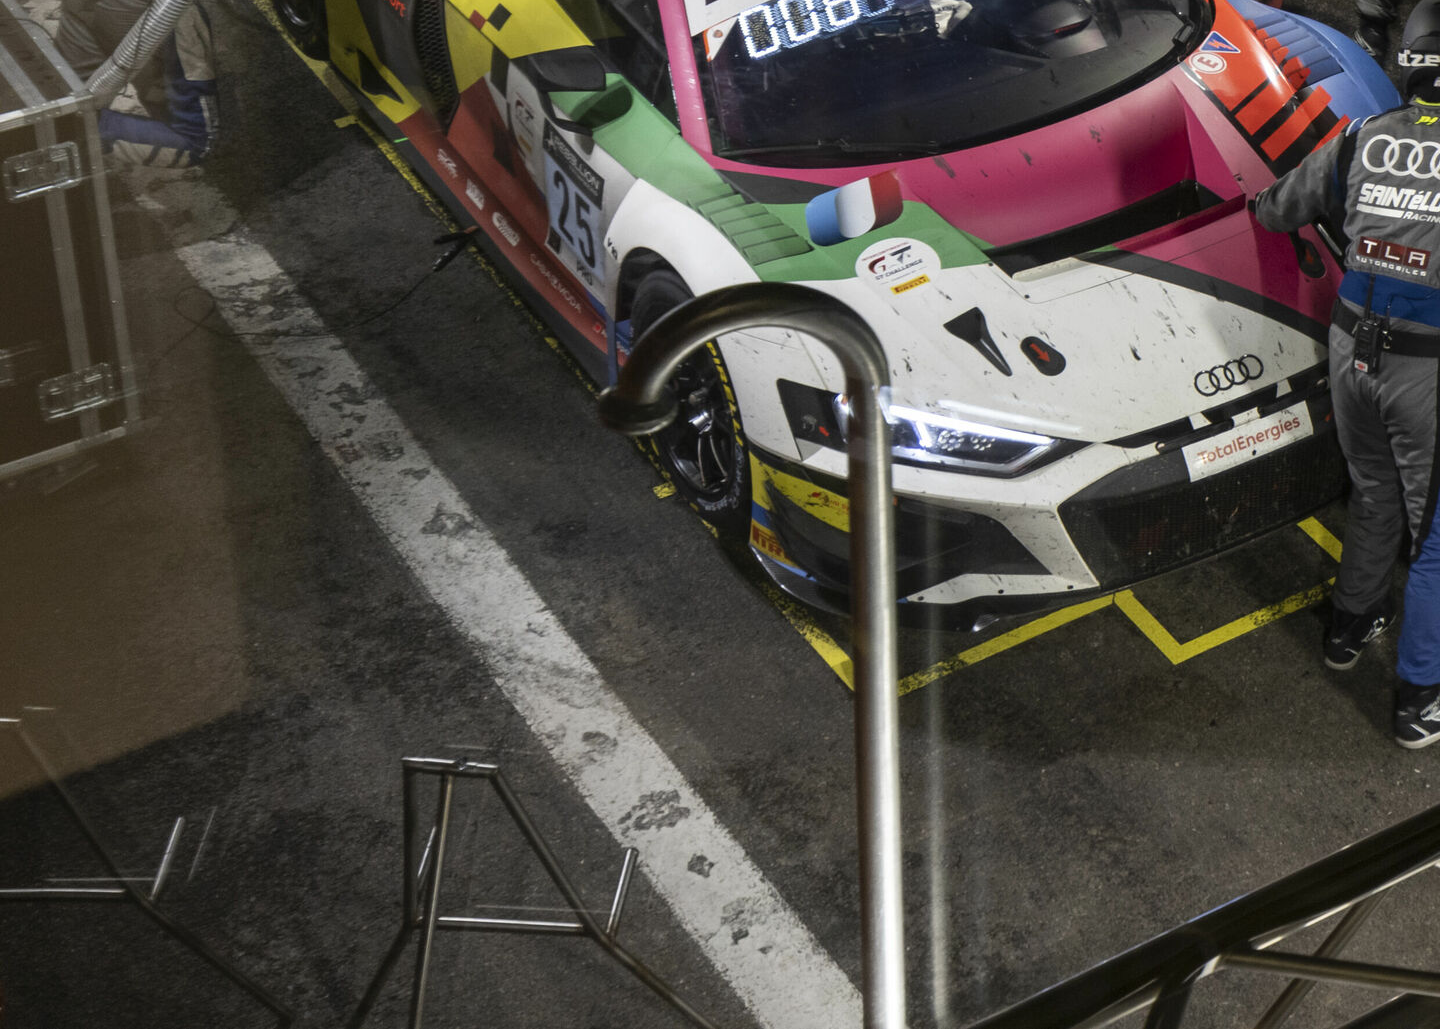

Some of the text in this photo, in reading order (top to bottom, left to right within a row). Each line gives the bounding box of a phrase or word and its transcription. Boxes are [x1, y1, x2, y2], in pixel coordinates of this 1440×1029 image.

[554, 170, 595, 269] 25
[1363, 239, 1427, 267] TLA
[1197, 416, 1301, 464] TotalEnergies
